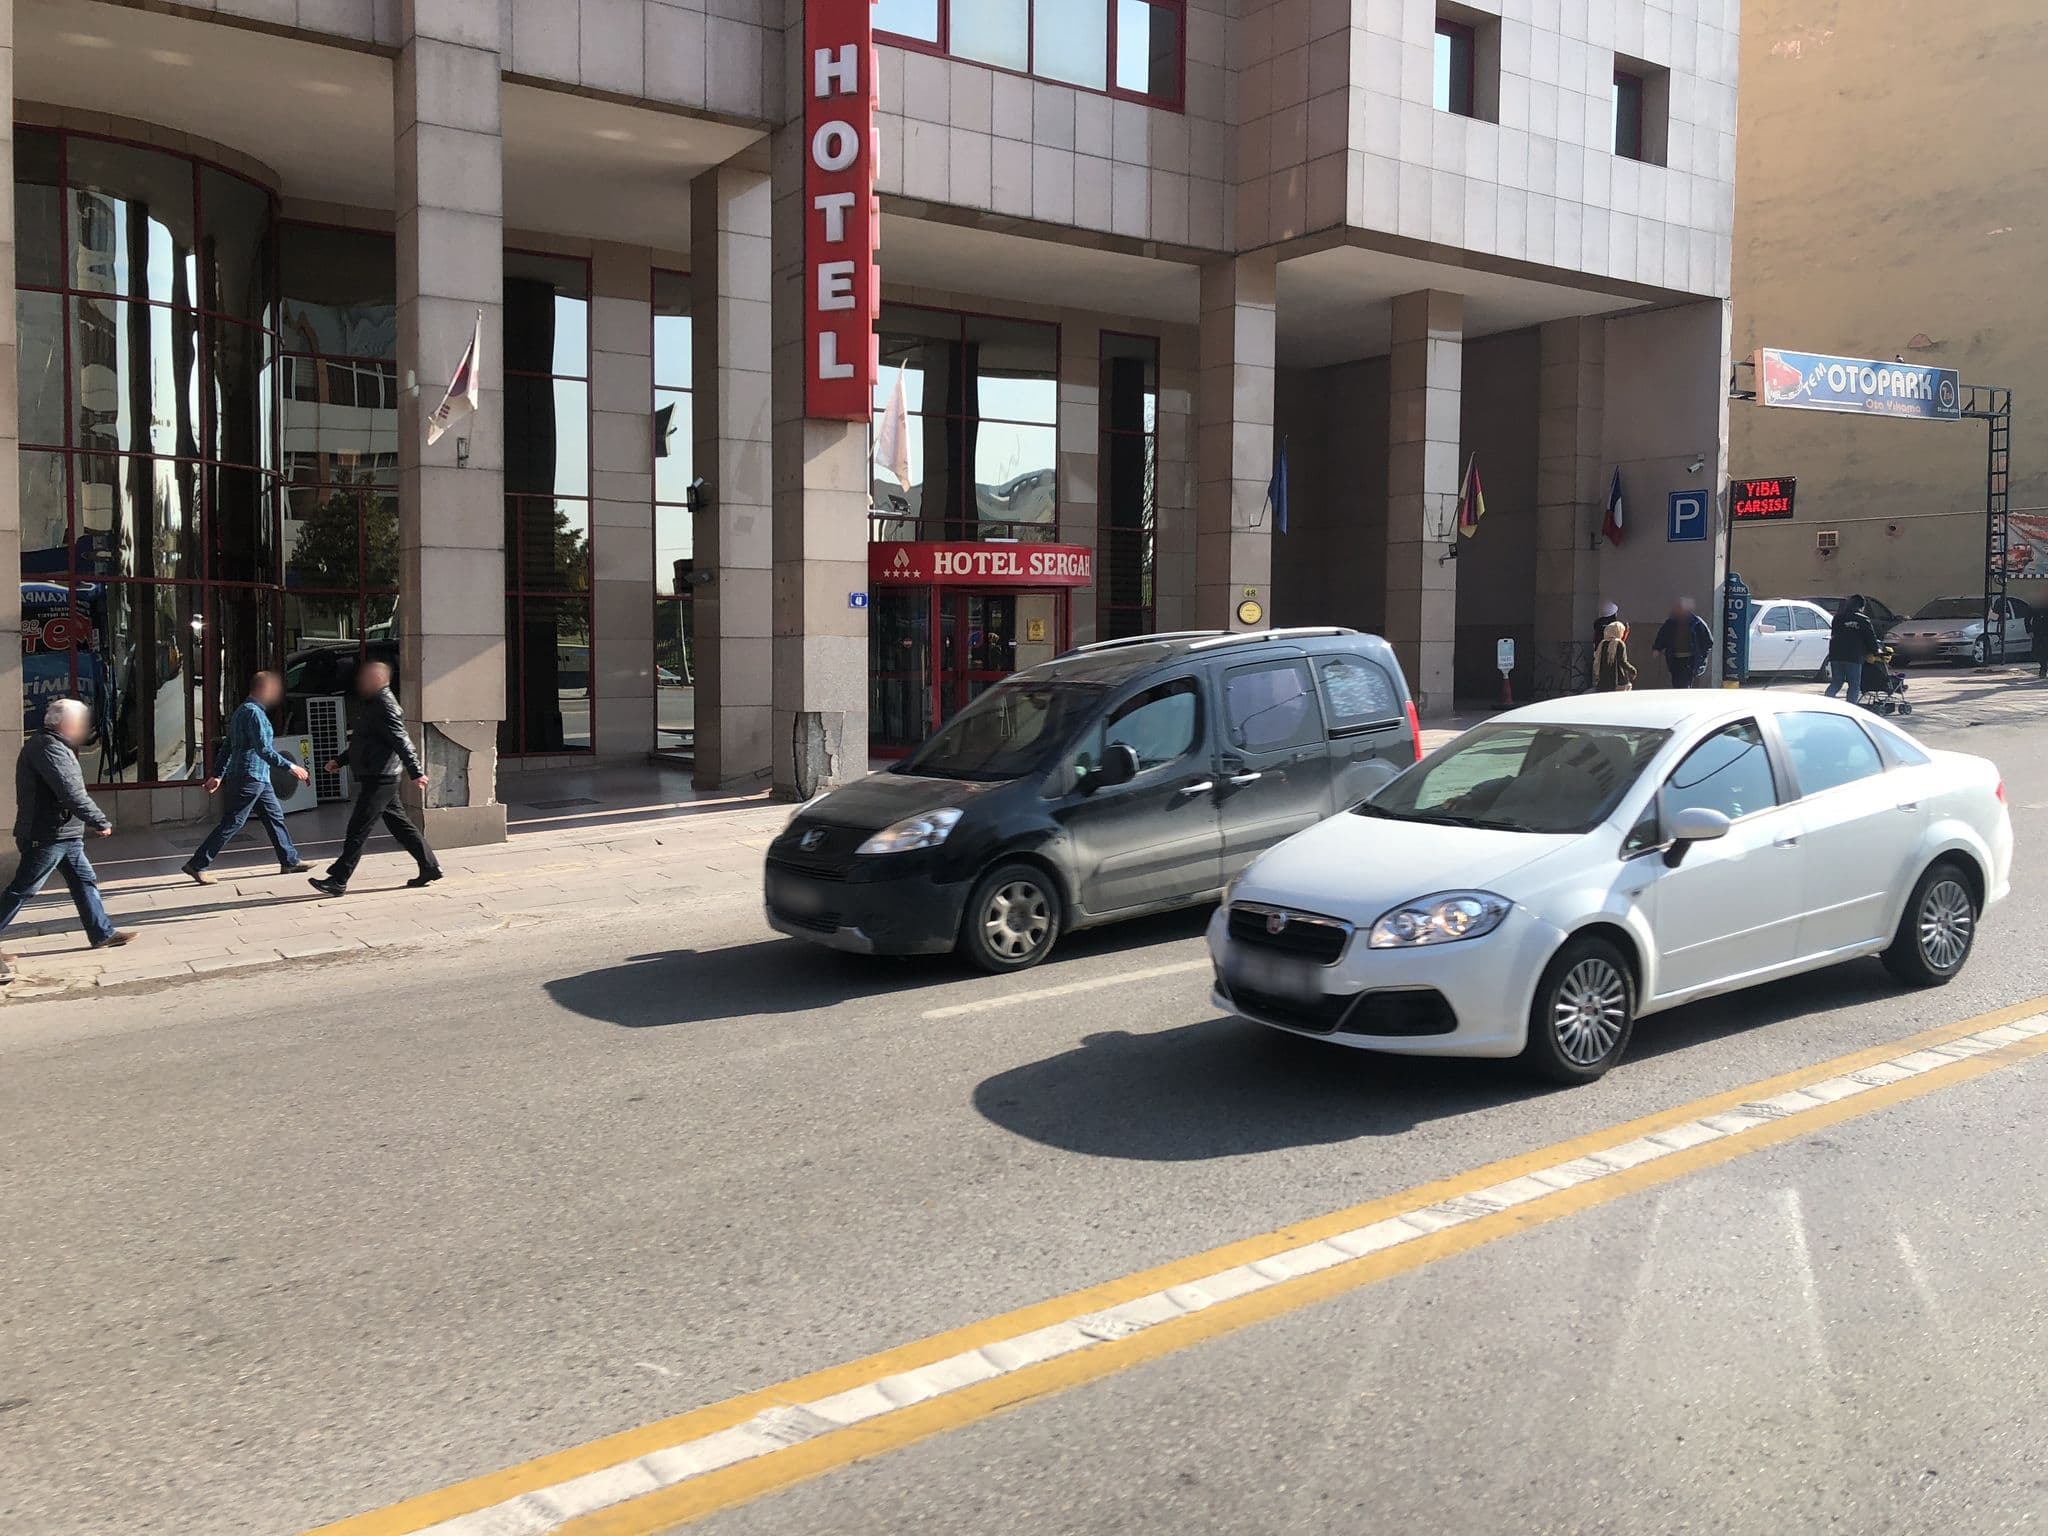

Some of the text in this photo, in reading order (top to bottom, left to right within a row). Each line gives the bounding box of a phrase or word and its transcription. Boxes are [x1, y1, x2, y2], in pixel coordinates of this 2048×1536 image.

[812, 44, 859, 380] HOTEL
[1827, 364, 1932, 400] OTOPARK
[1865, 399, 1884, 410] Oto
[1676, 499, 1700, 534] P
[934, 552, 1090, 577] HOTEL SERGAH
